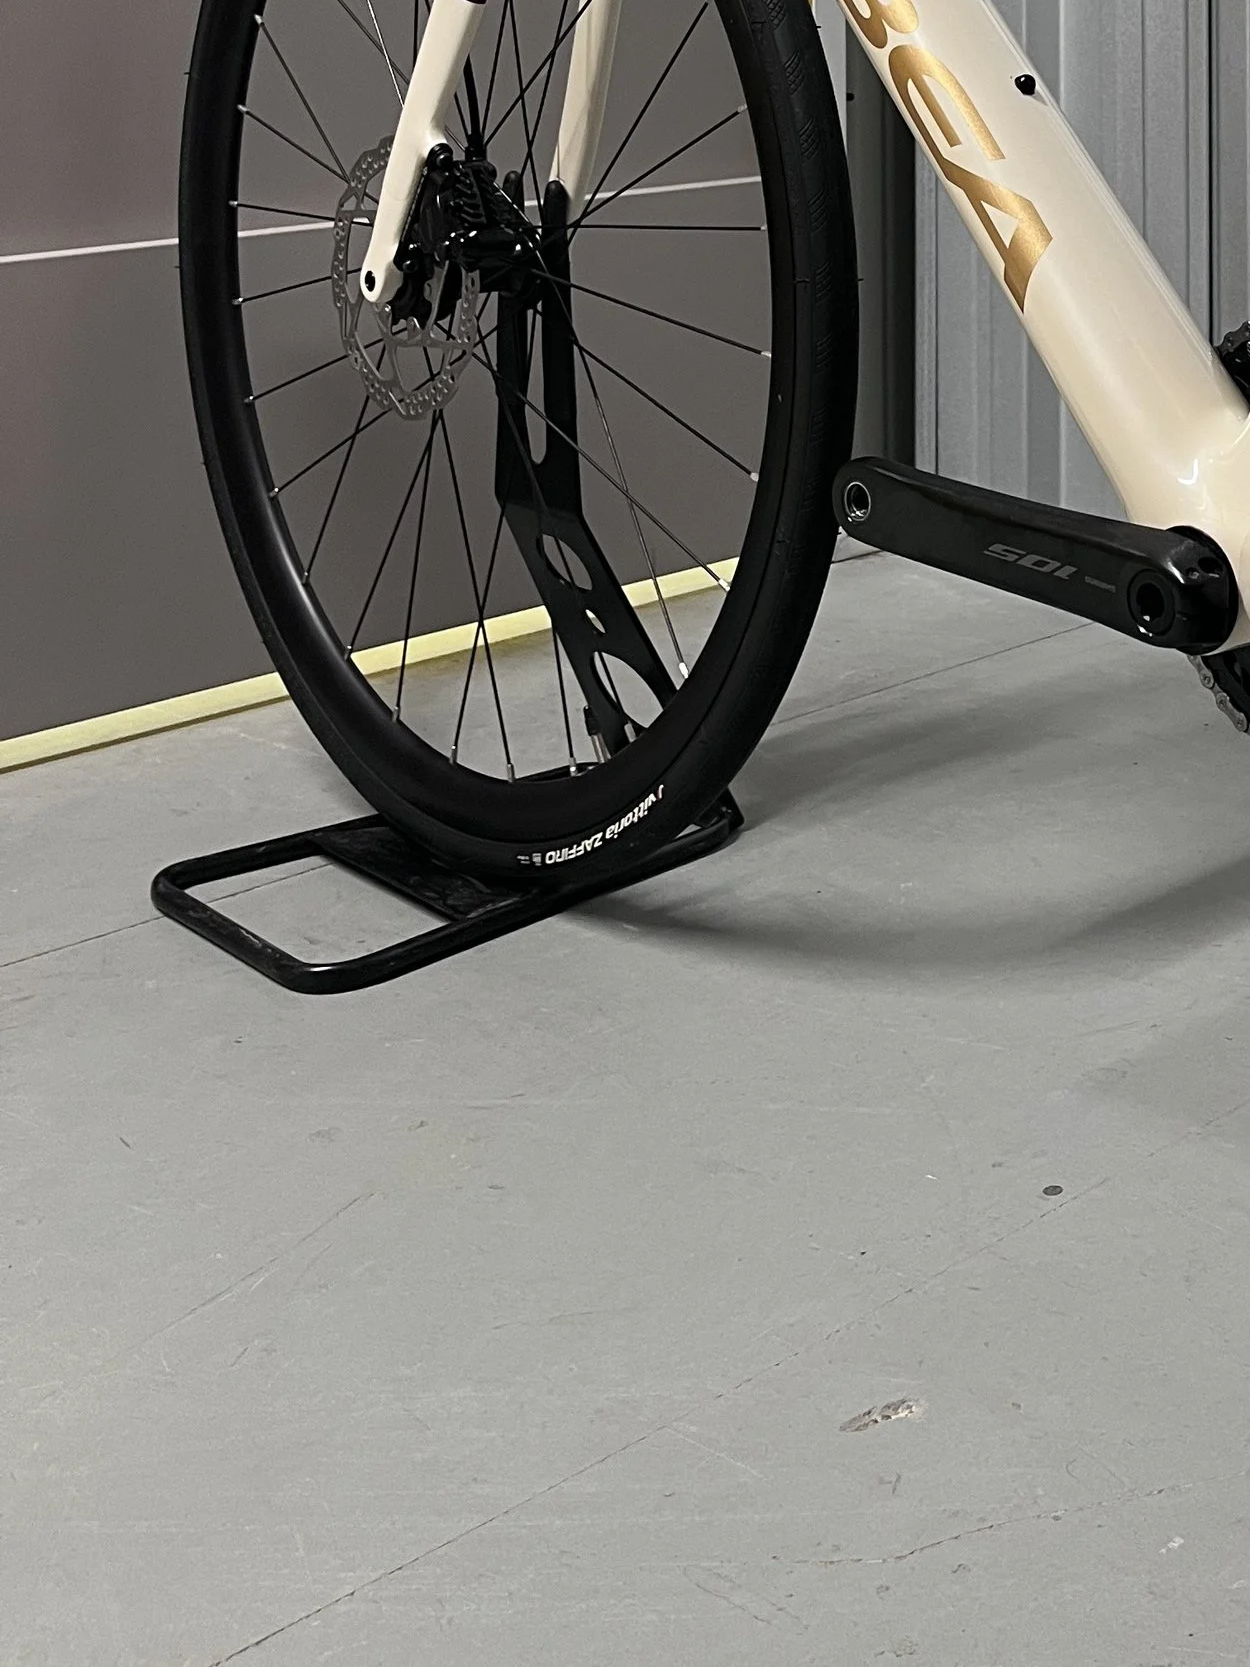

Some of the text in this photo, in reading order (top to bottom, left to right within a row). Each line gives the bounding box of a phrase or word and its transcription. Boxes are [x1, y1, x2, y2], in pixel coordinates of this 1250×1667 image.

[983, 542, 1079, 579] 105
[545, 792, 657, 865] vittoria ZAFFIRO
